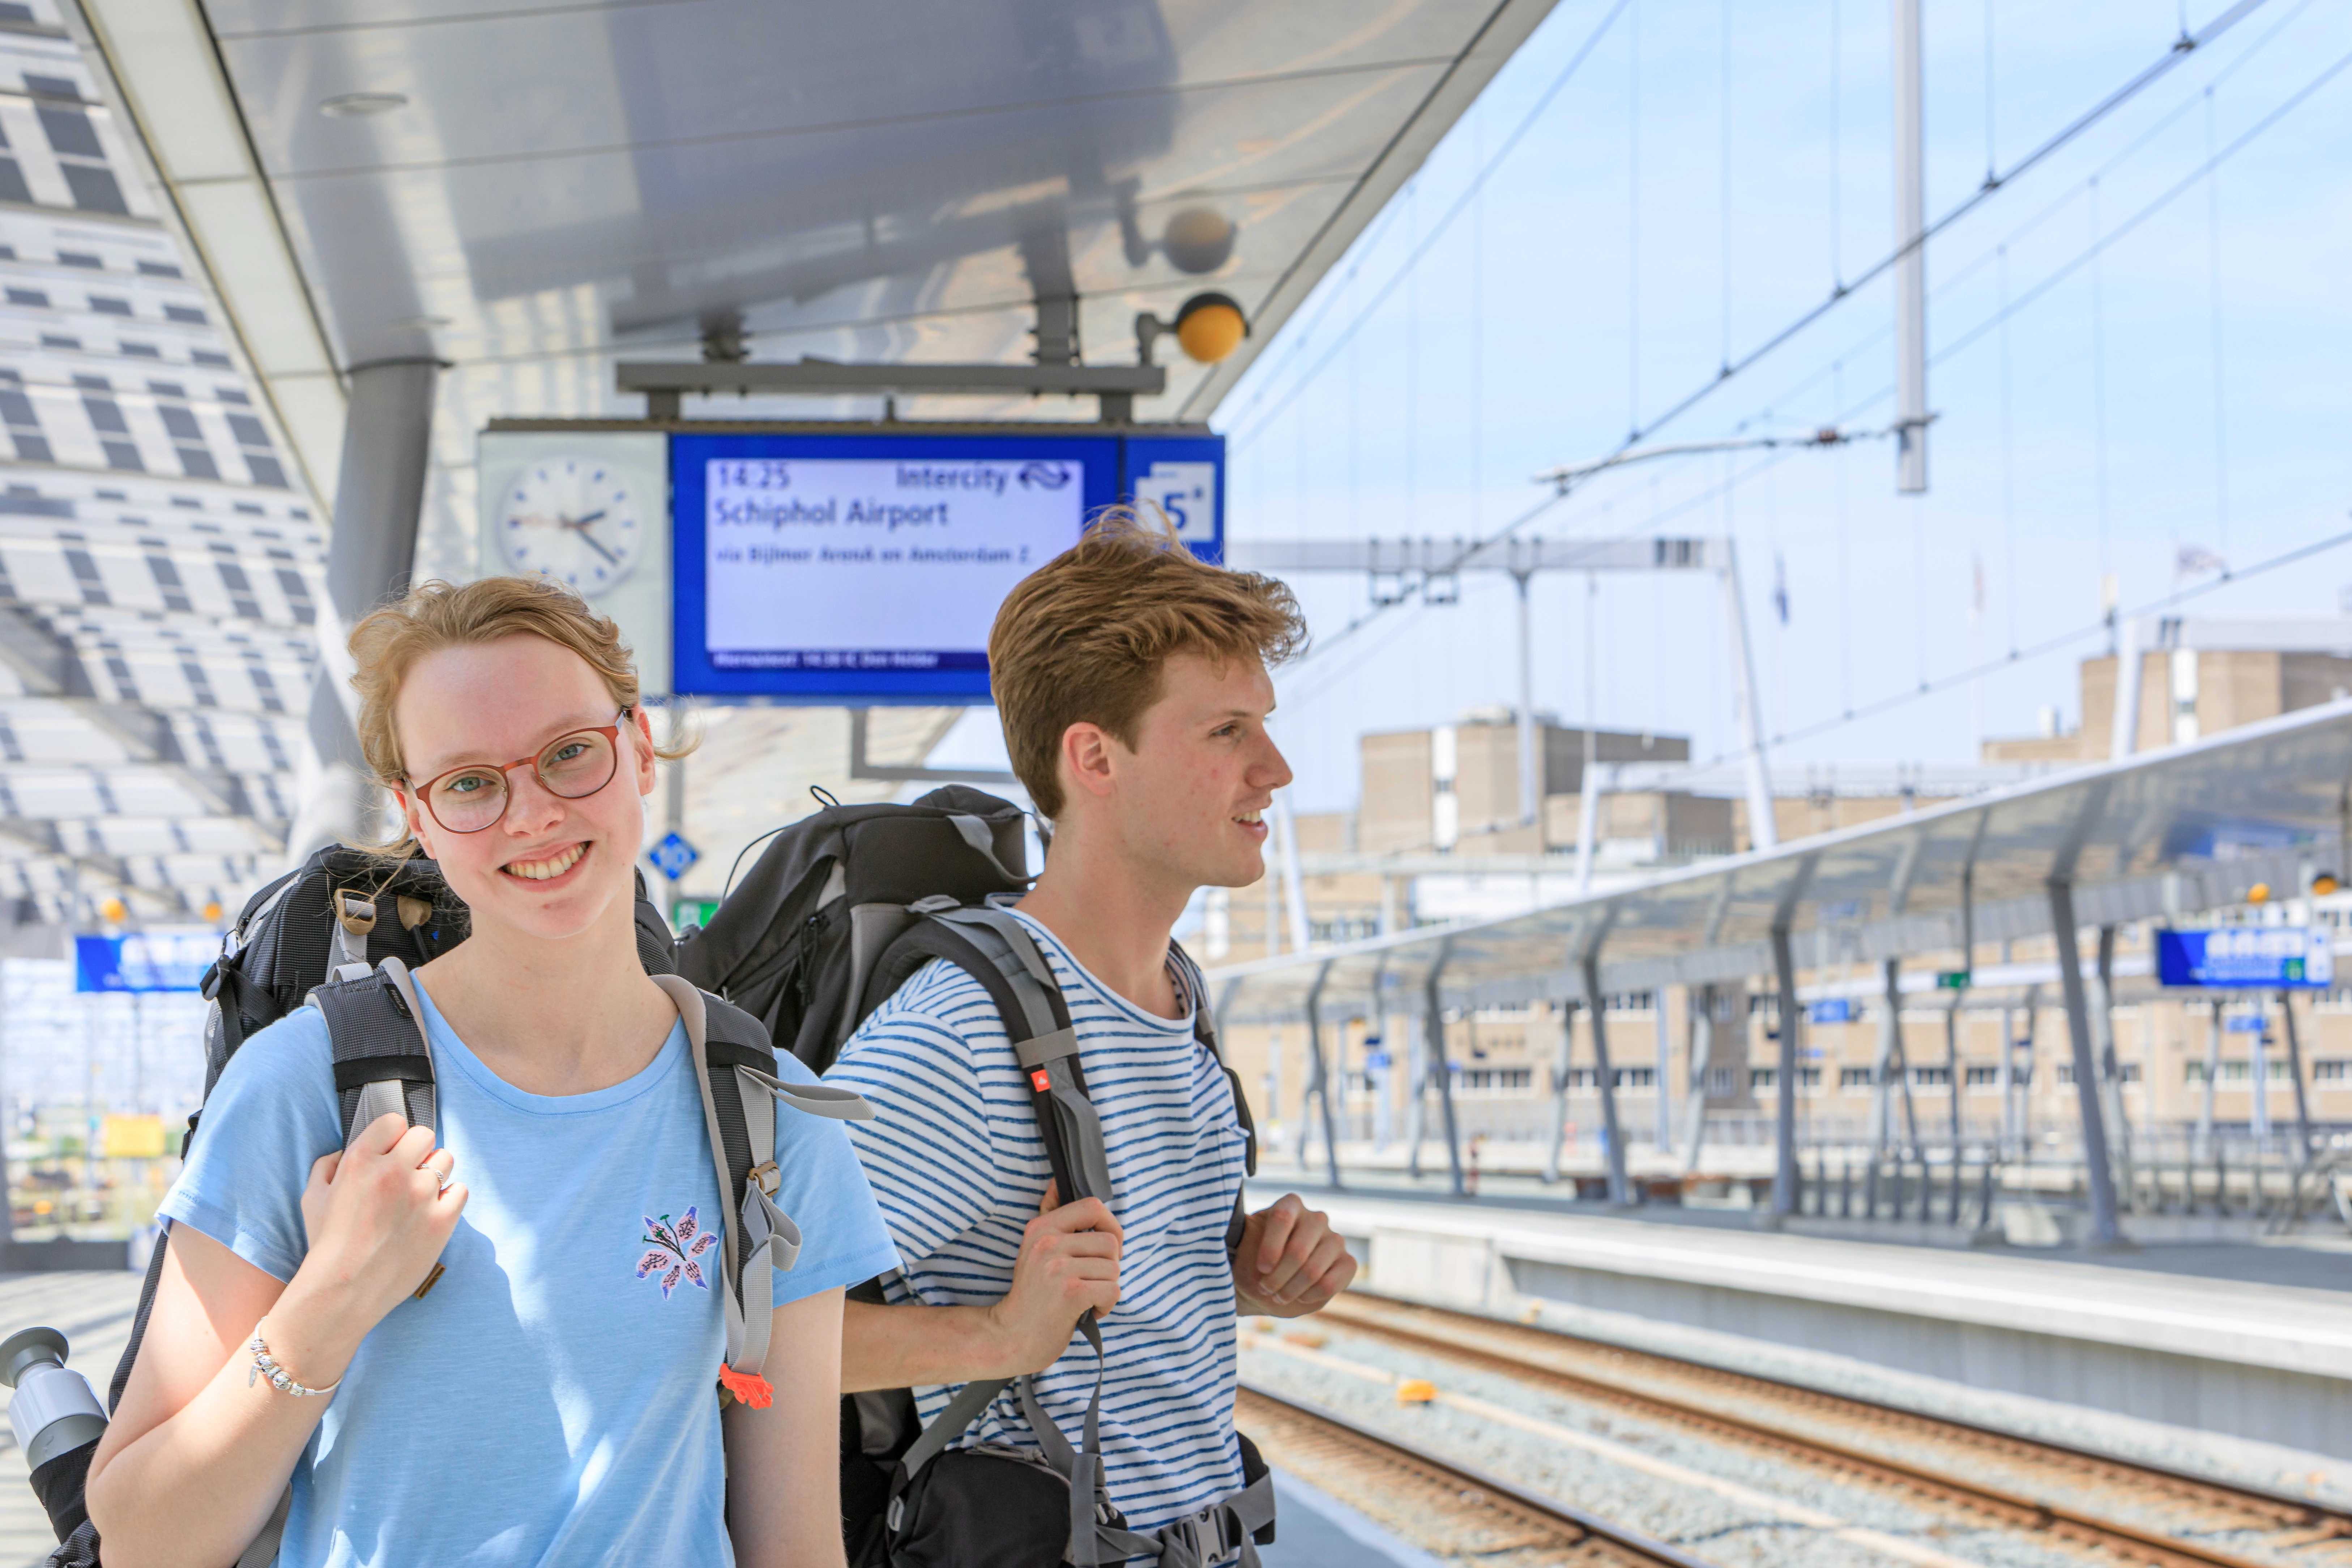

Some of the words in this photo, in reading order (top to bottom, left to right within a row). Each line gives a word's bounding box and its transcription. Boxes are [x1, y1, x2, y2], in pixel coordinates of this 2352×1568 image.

[897, 462, 1009, 496] Intercity
[714, 497, 836, 531] Schiphol
[846, 499, 949, 531] Airport
[715, 545, 743, 563] via
[748, 545, 813, 567] Bijlmer
[909, 545, 1013, 563] Amsterdam
